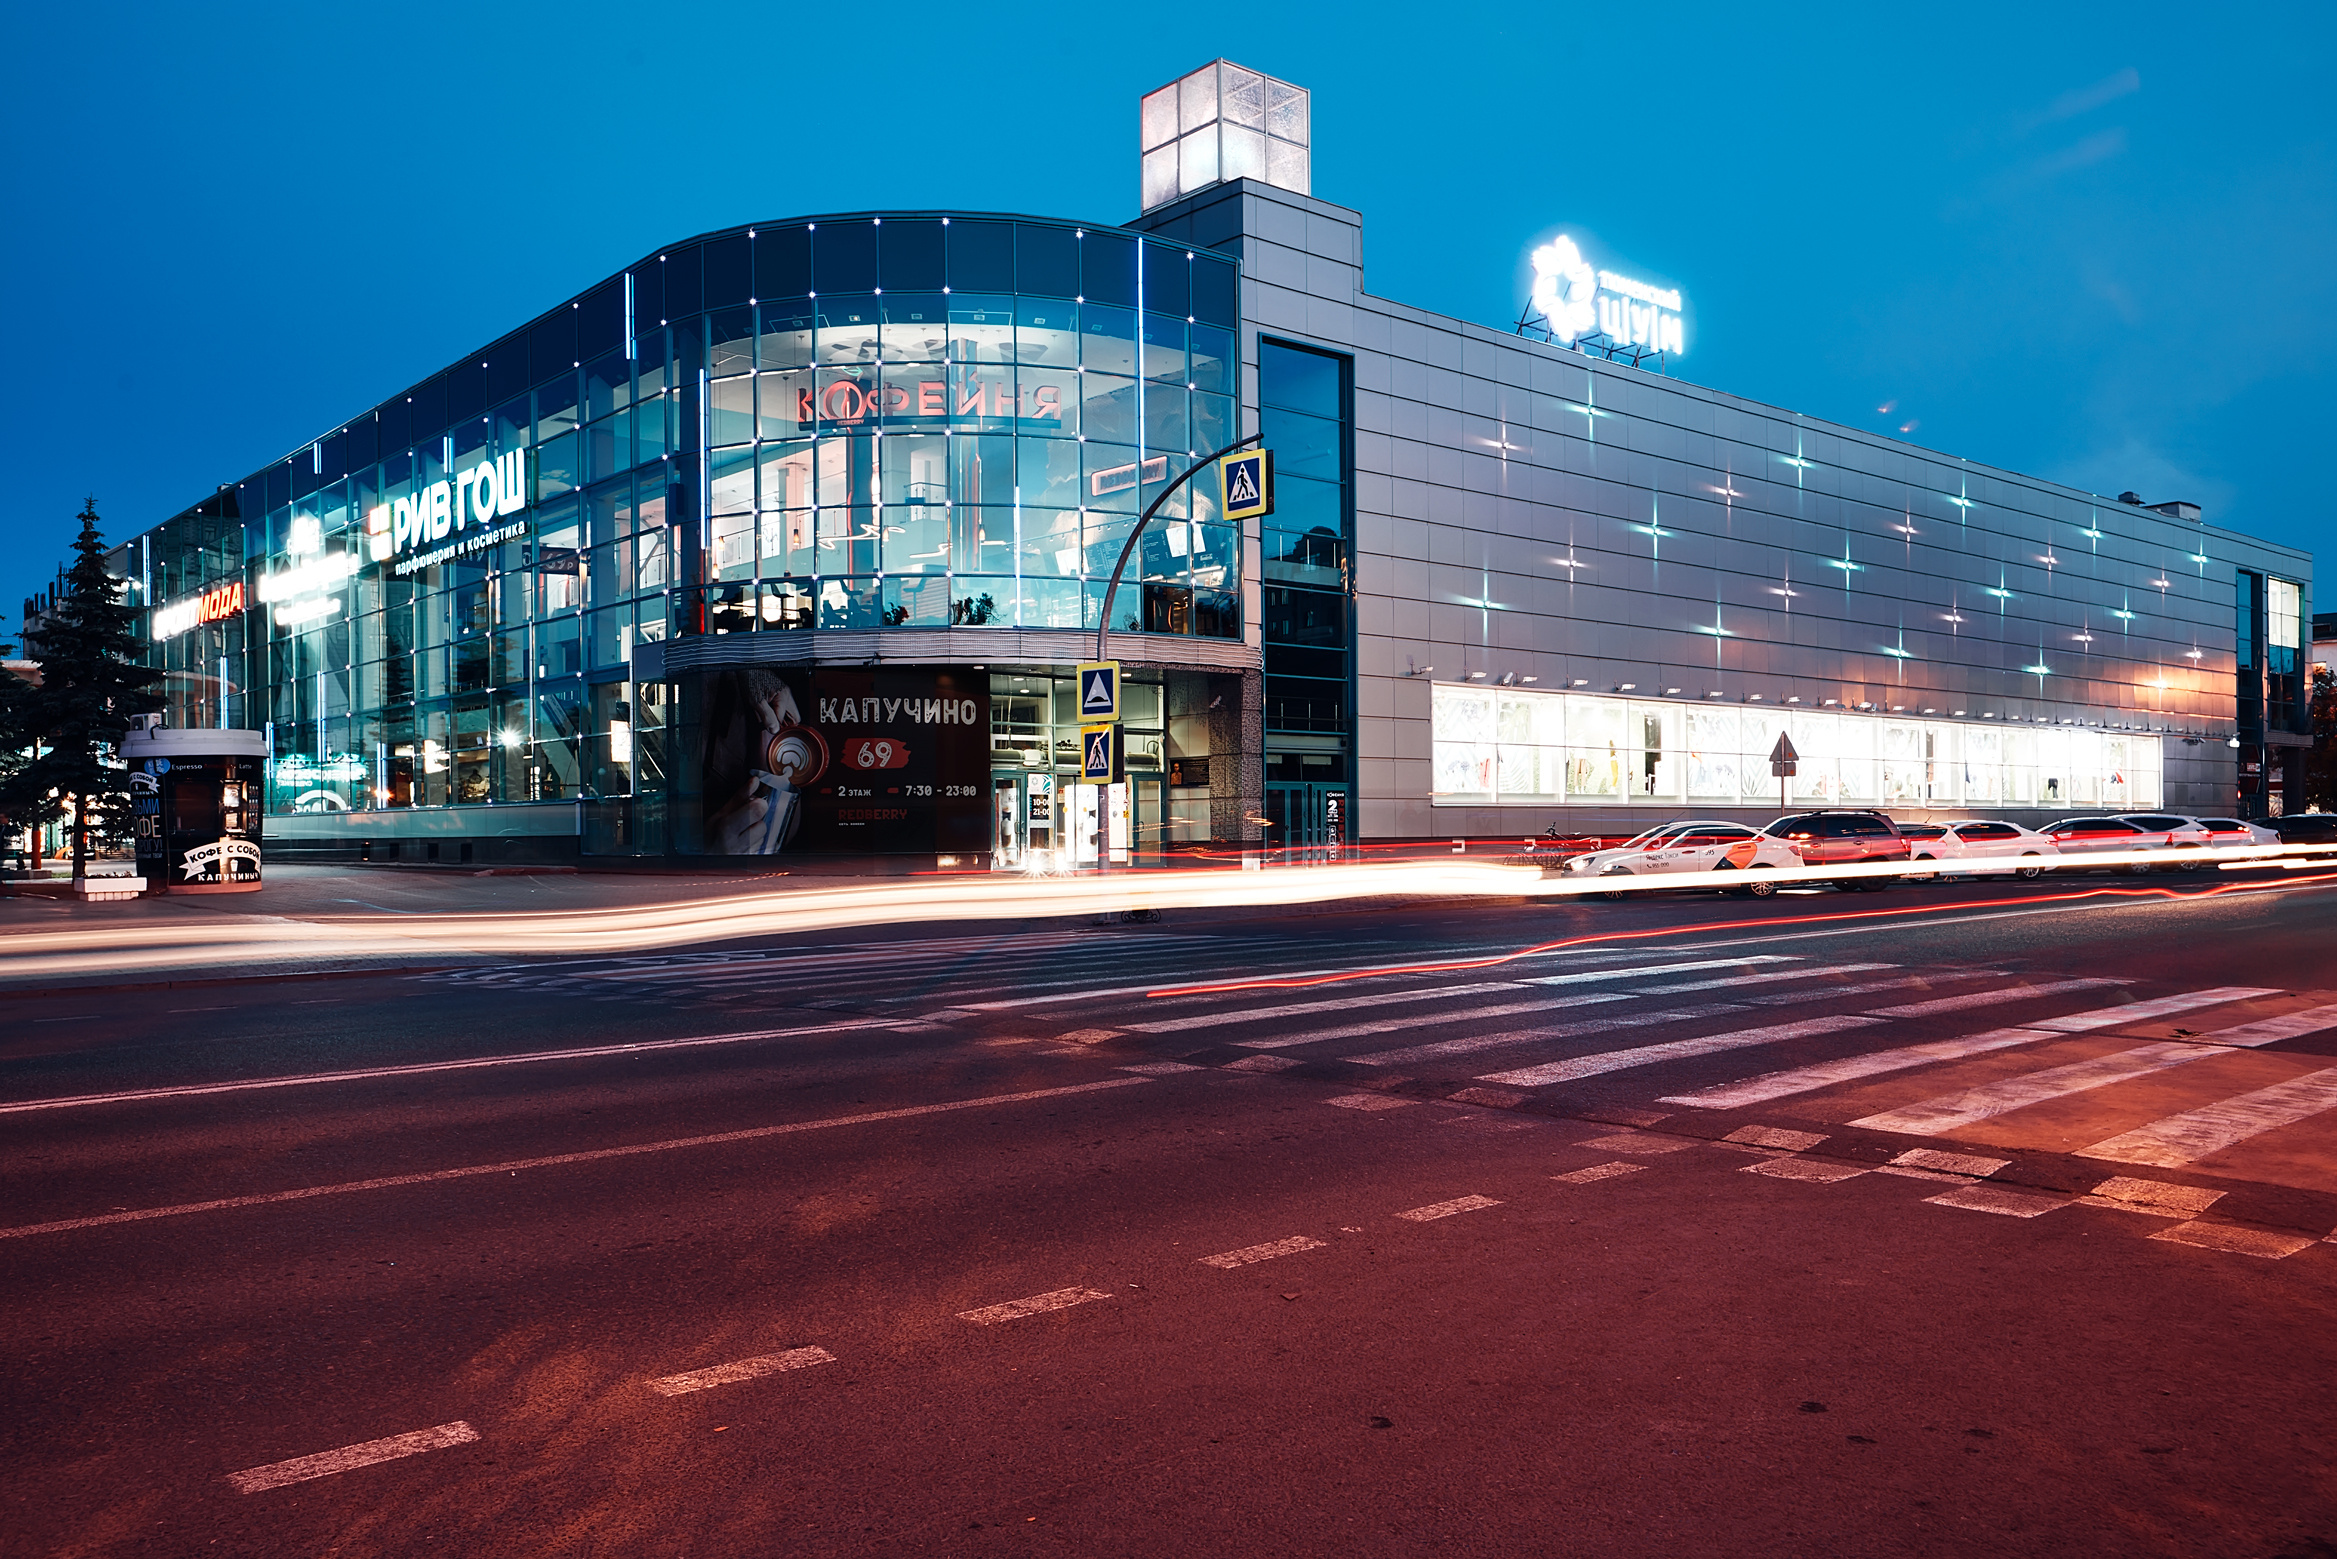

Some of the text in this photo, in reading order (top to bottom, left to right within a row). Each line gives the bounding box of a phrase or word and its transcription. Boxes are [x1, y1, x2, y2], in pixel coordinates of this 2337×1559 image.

[797, 371, 1063, 423] КОФЕЙНЯ
[394, 480, 451, 554] РИВ
[457, 447, 525, 532] ГОШ
[395, 544, 455, 576] парфюмерия
[458, 542, 464, 555] и
[467, 521, 525, 552] косметика
[819, 697, 977, 726] КАПУЧИНО
[857, 741, 893, 768] 69
[838, 786, 872, 797] 2 ЭТАЖ
[905, 785, 932, 797] 7:30
[946, 785, 977, 797] 23:00
[838, 808, 908, 820] REDBERRY
[189, 846, 222, 864] КОФЕ
[227, 845, 234, 853] С
